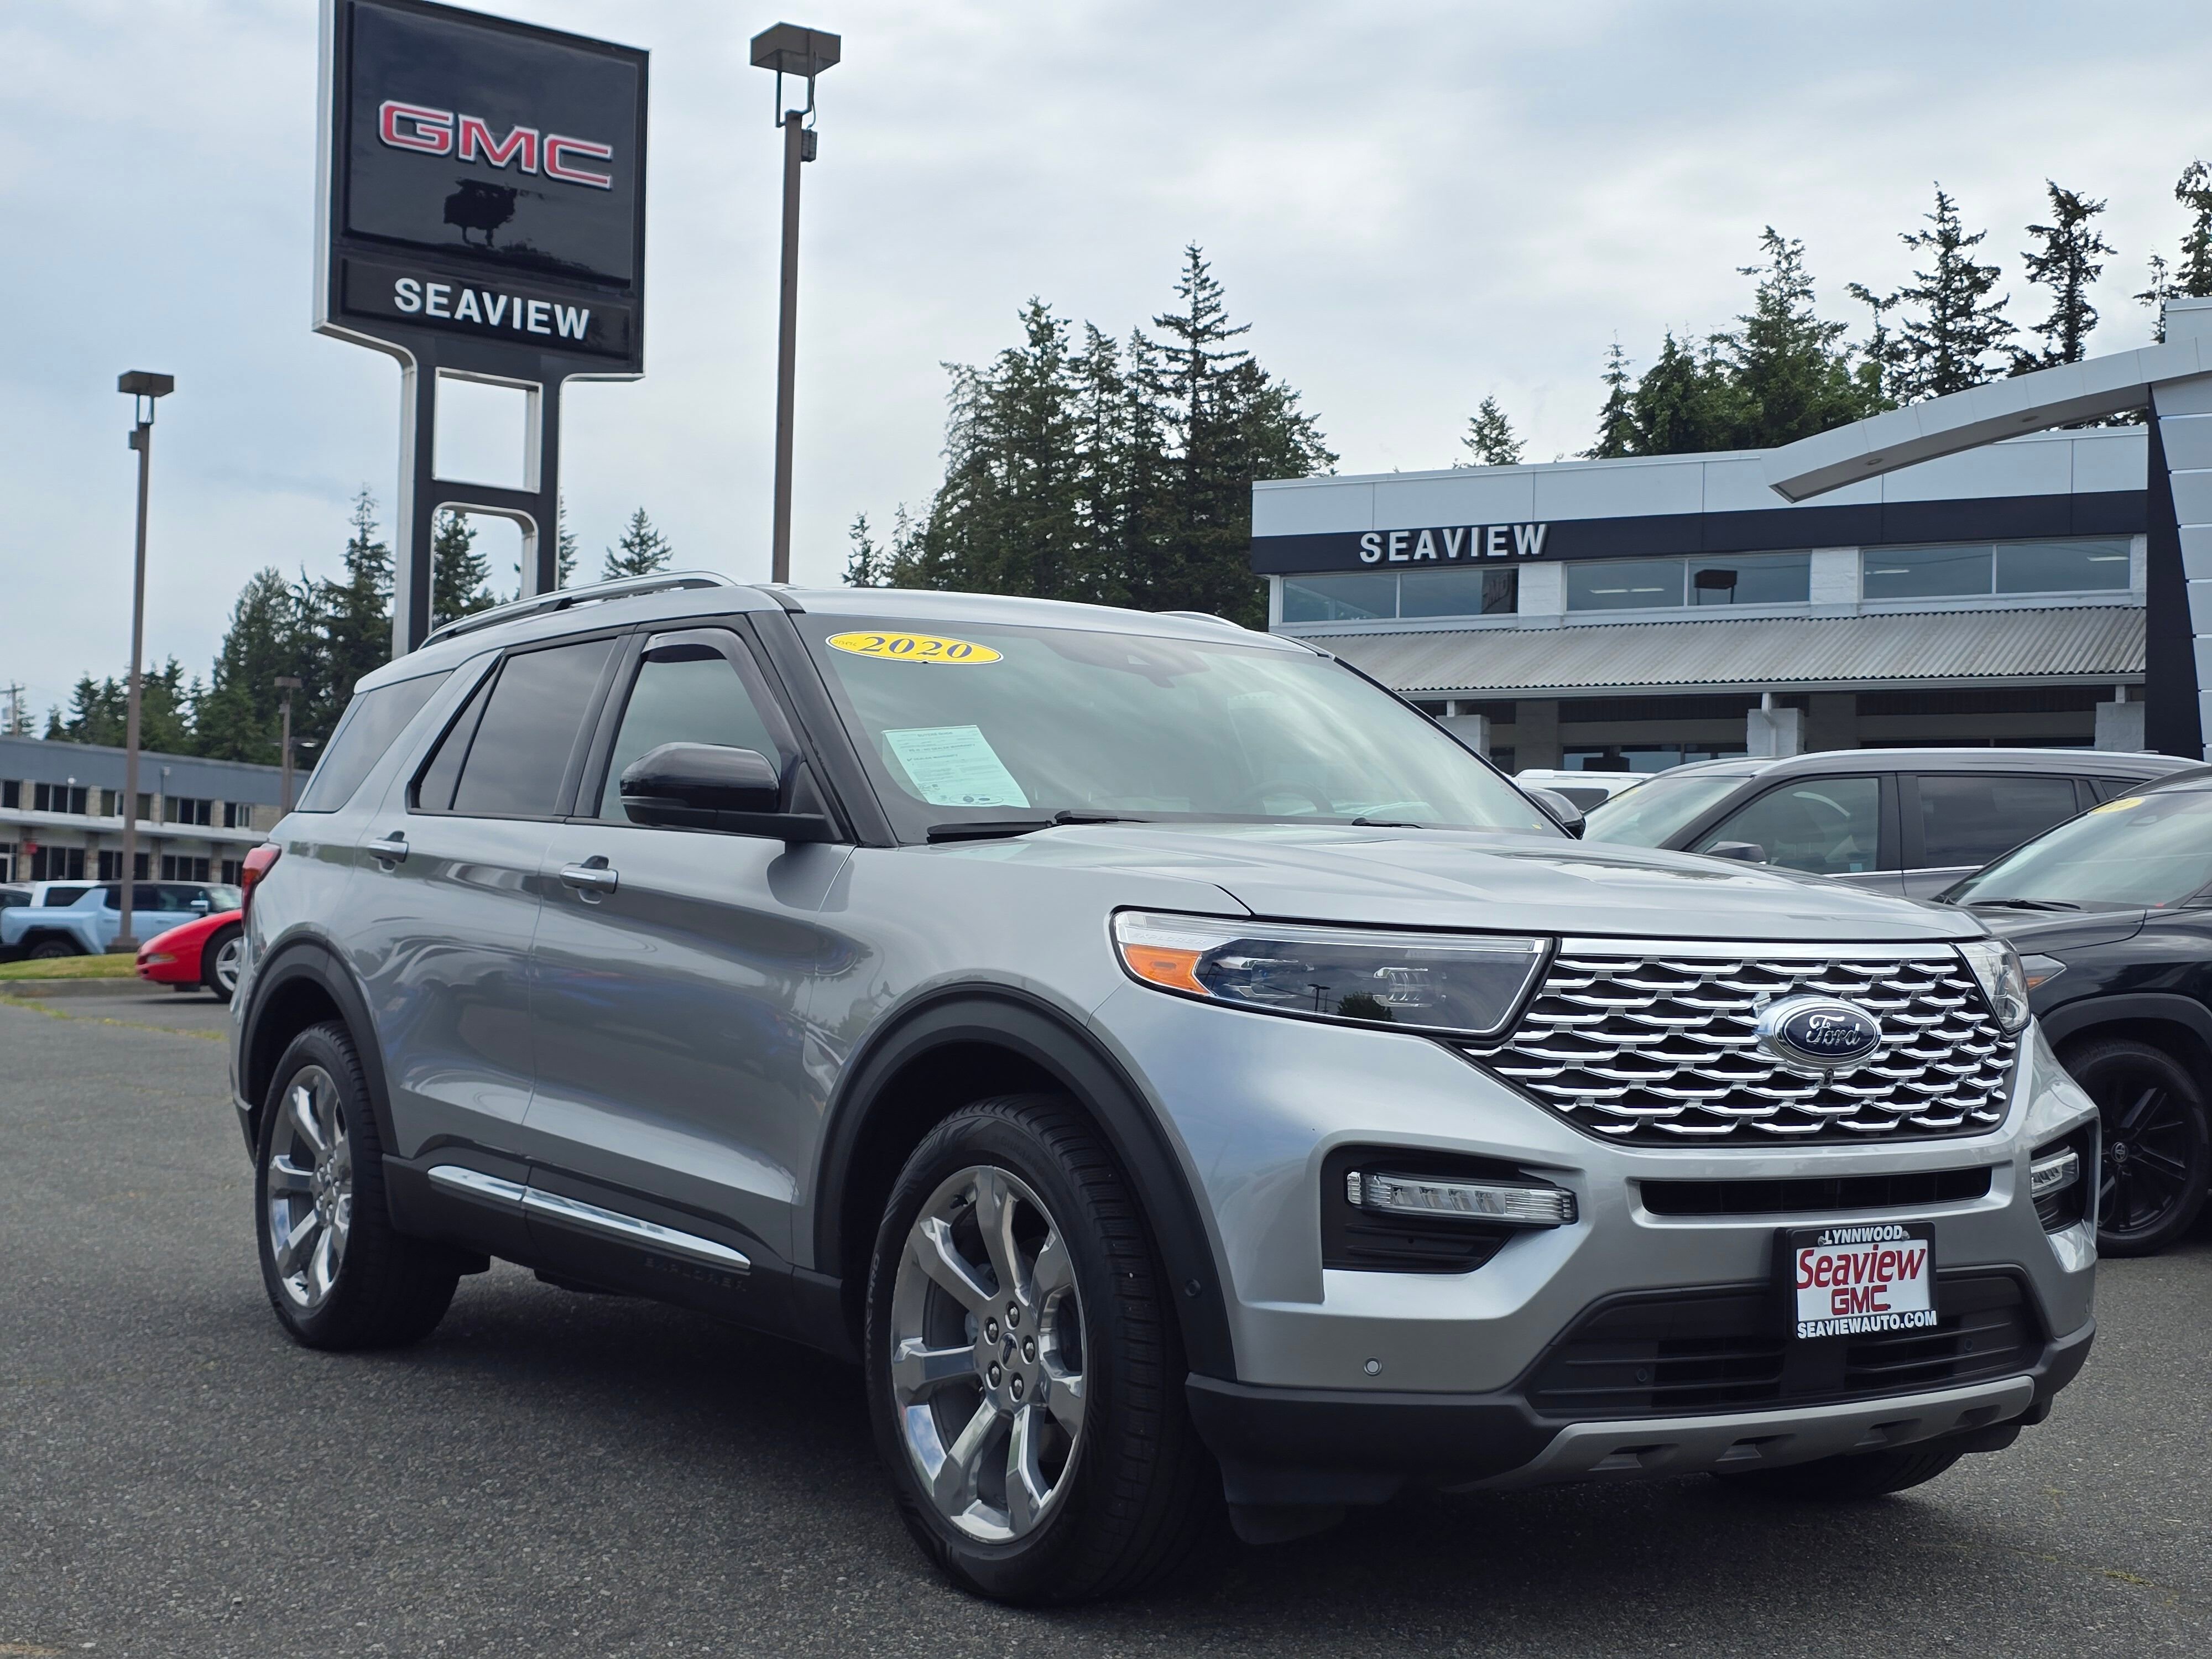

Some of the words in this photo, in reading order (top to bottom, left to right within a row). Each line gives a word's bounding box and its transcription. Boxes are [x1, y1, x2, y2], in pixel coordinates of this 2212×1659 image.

[379, 100, 612, 190] GMC
[394, 278, 589, 340] SEAVIEW
[1360, 524, 1547, 564] SEAVIEW
[858, 636, 972, 658] 2020
[1806, 1014, 1860, 1046] Ford
[1824, 1225, 1903, 1245] LYNNWOOD
[1797, 1244, 1926, 1290] Seaview
[1831, 1284, 1888, 1316] GMC
[1797, 1311, 1937, 1339] SEAVIEWAUTO.COM
